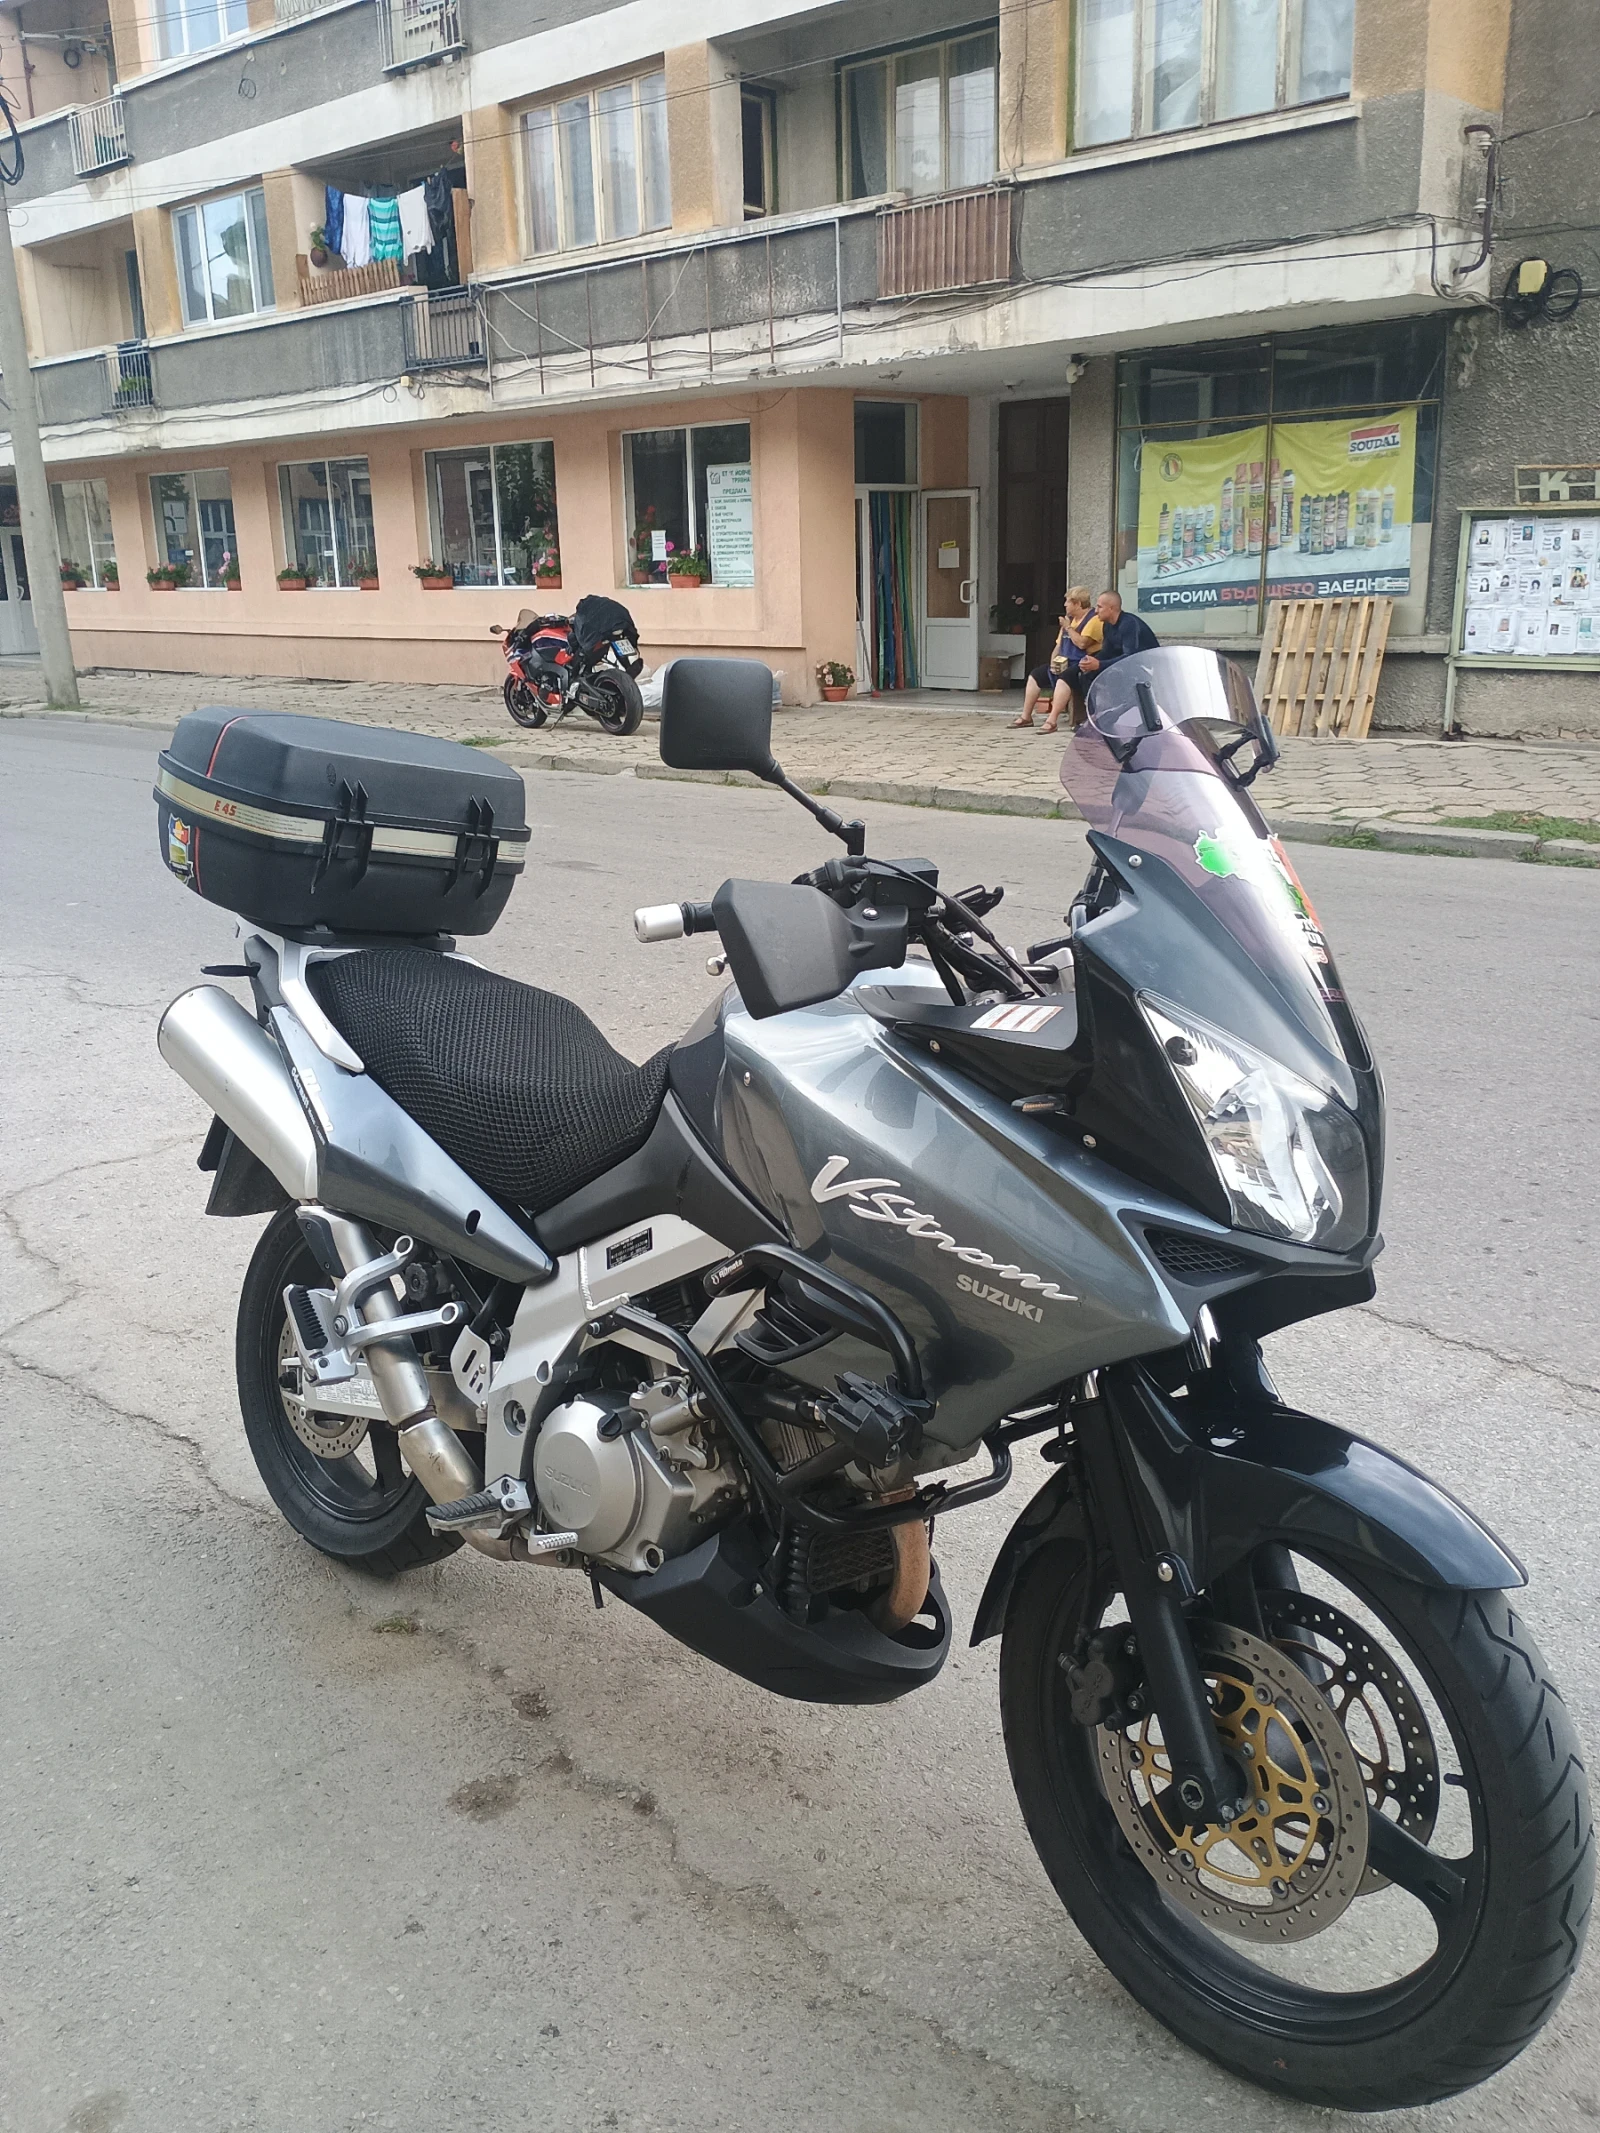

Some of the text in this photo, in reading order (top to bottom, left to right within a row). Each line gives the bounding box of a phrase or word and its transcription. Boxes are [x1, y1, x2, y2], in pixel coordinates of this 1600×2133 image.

[1349, 435, 1400, 452] SOUDAL
[1150, 589, 1218, 605] СТРОИМ
[1221, 583, 1315, 601] БЪДЩЕТО
[1318, 577, 1381, 595] ЗАЕДН
[214, 799, 237, 817] E 45
[956, 1274, 1044, 1323] SUZUKI
